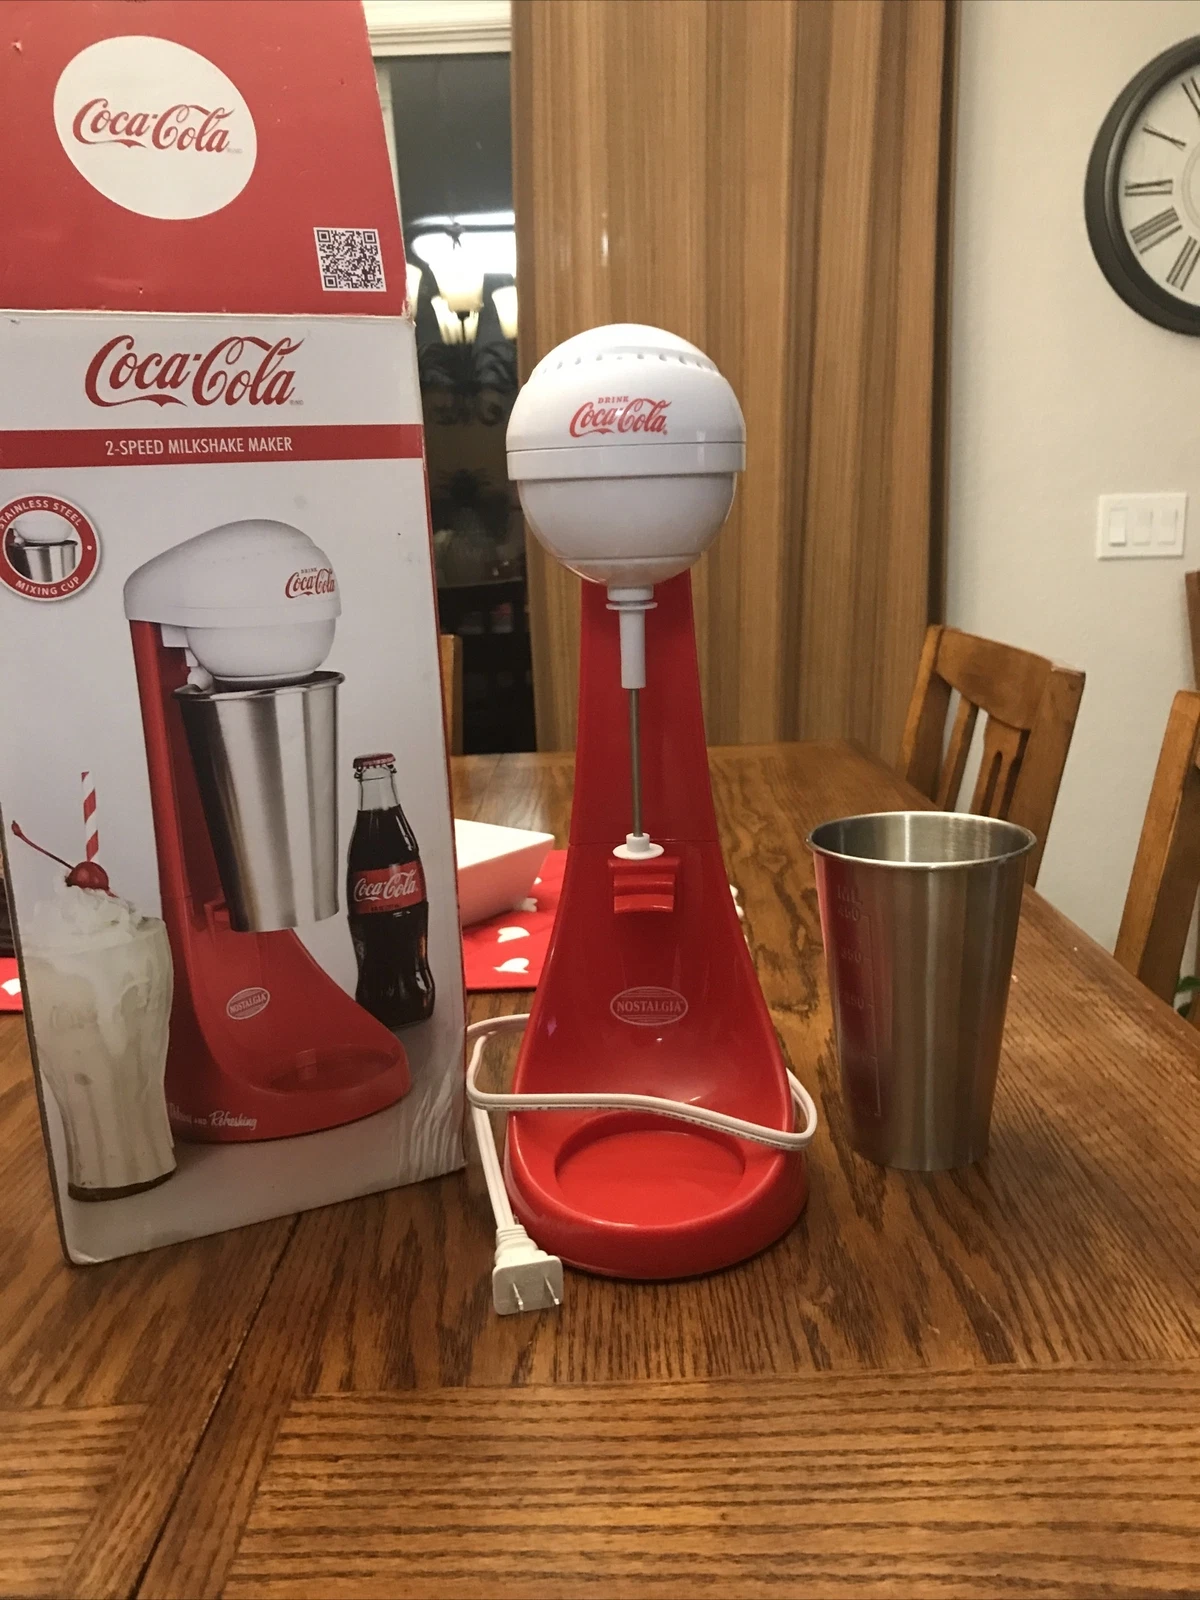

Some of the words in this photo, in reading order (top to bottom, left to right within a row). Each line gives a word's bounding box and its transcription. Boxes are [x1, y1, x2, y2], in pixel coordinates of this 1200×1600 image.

[72, 98, 235, 153] Coca-Cola
[85, 335, 305, 407] Coca-Cola
[598, 396, 629, 404] DRINK
[569, 398, 672, 438] Coca-Cola
[105, 439, 164, 456] 2-SPEED
[168, 437, 245, 454] MILKSHAKE
[248, 436, 293, 452] MAKER
[53, 502, 82, 527] STEEL
[15, 580, 58, 595] MIXING
[60, 576, 80, 592] CUP
[285, 568, 335, 599] Coca-Cola
[354, 869, 417, 902] Coca-Cola
[230, 993, 267, 1014] NOSTALGIA
[616, 1000, 682, 1012] NOSTALGIA
[209, 1110, 258, 1131] Refreshing
